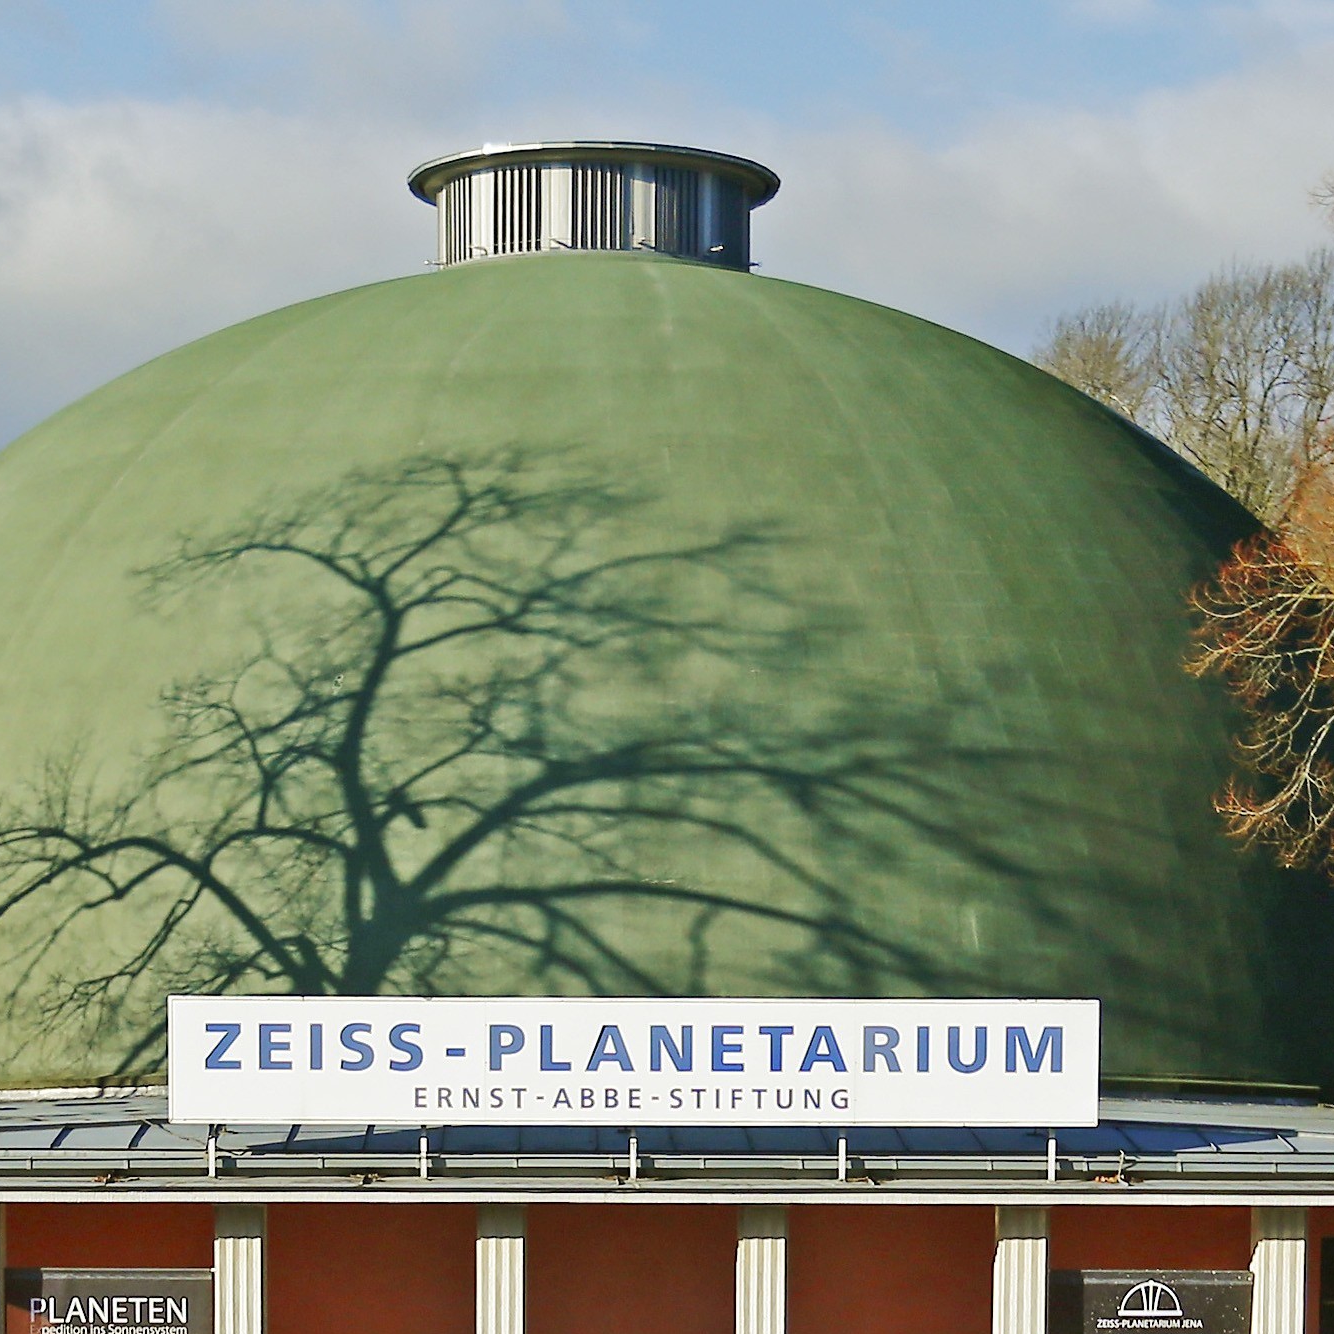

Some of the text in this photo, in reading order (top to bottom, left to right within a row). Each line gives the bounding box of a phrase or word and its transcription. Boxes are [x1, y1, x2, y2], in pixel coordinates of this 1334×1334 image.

[204, 1022, 1064, 1074] ZEISS-PLANETARIUM
[414, 1087, 850, 1110] ERNST-ABBE-STIFTUNG
[29, 1297, 188, 1324] PLANETEN
[1181, 1318, 1204, 1329] JENA
